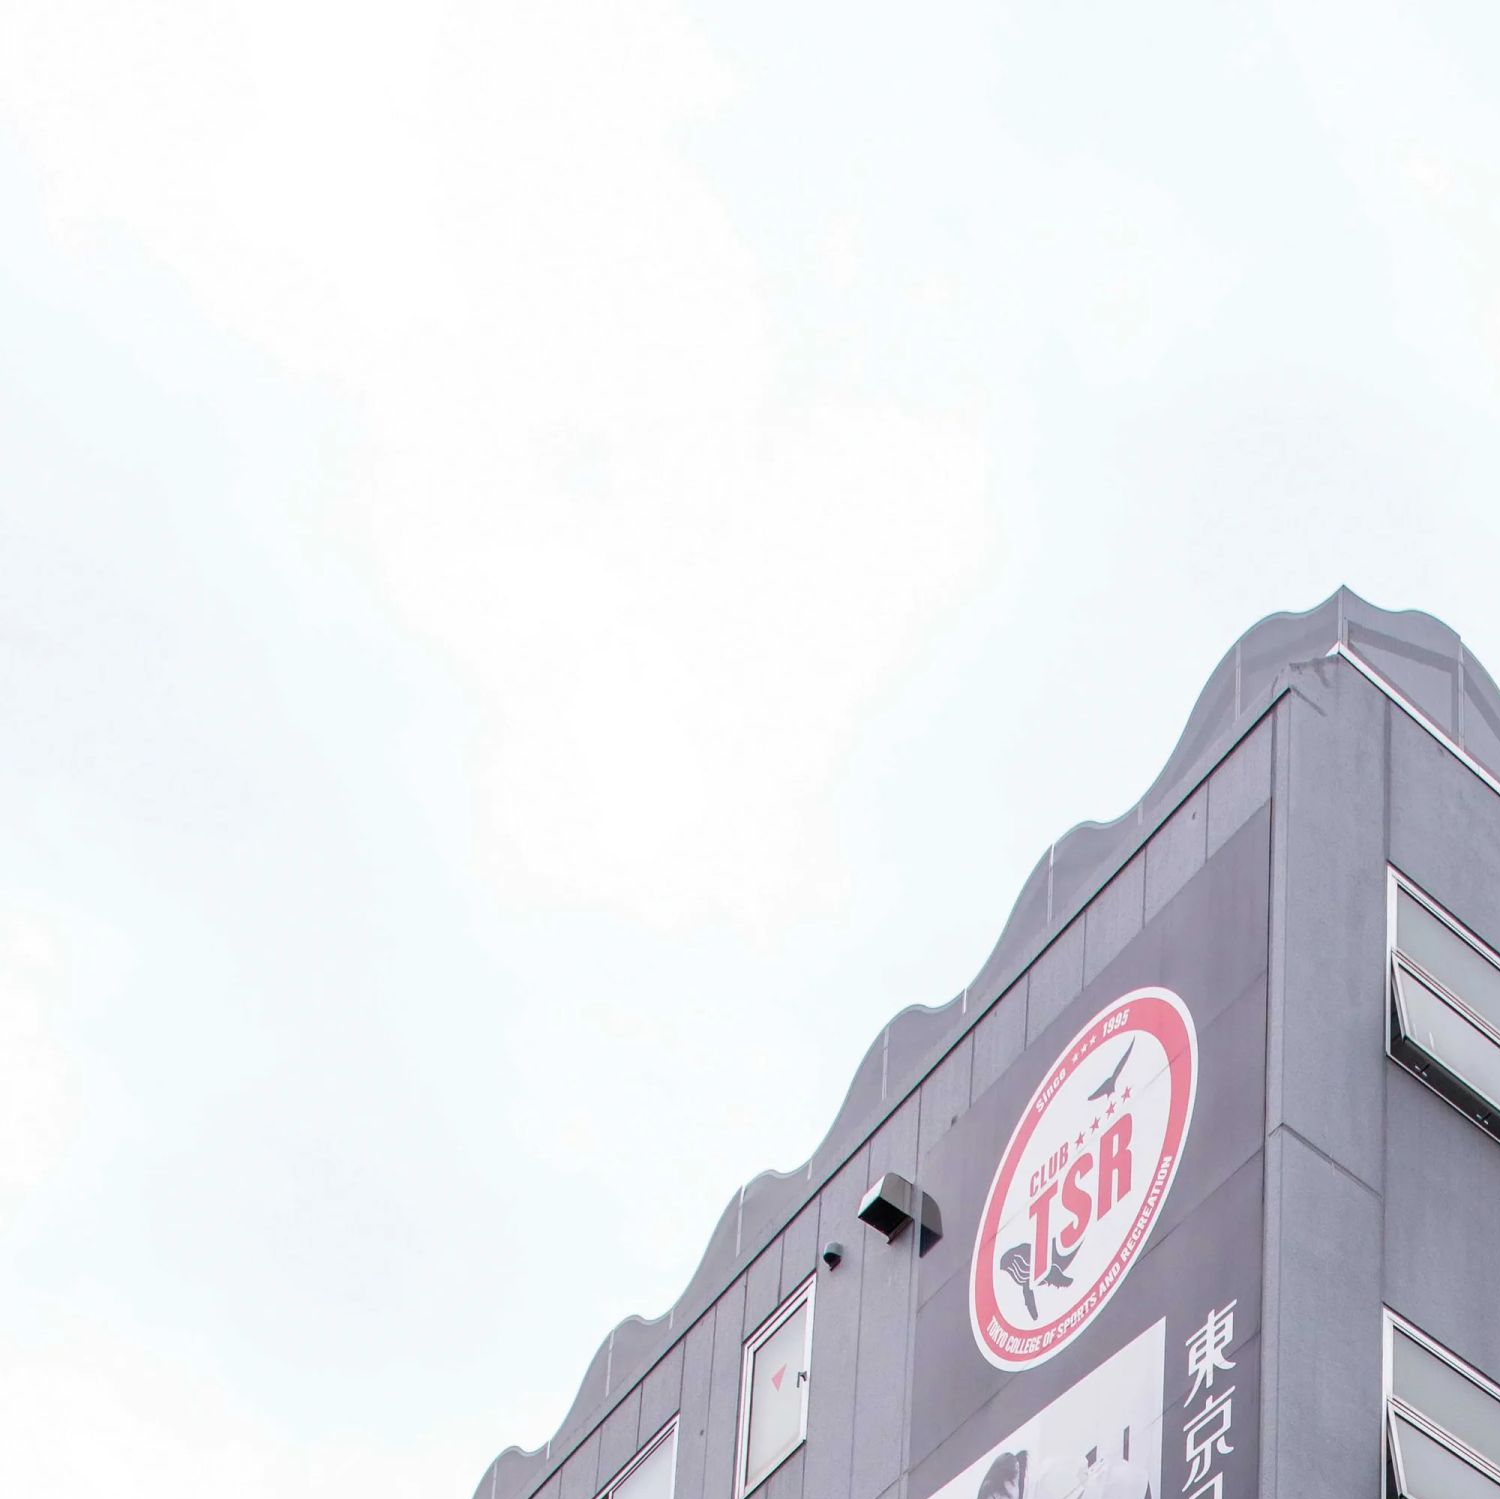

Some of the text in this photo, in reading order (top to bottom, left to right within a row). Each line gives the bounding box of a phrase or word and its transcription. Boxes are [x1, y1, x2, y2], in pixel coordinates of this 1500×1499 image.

[1035, 1008, 1130, 1113] Since 1995
[1029, 1141, 1069, 1198] CLUB
[1029, 1112, 1133, 1282] TSR
[986, 1155, 1173, 1355] TOKYO COLLEGE OF SPORTS AND RECREATION
